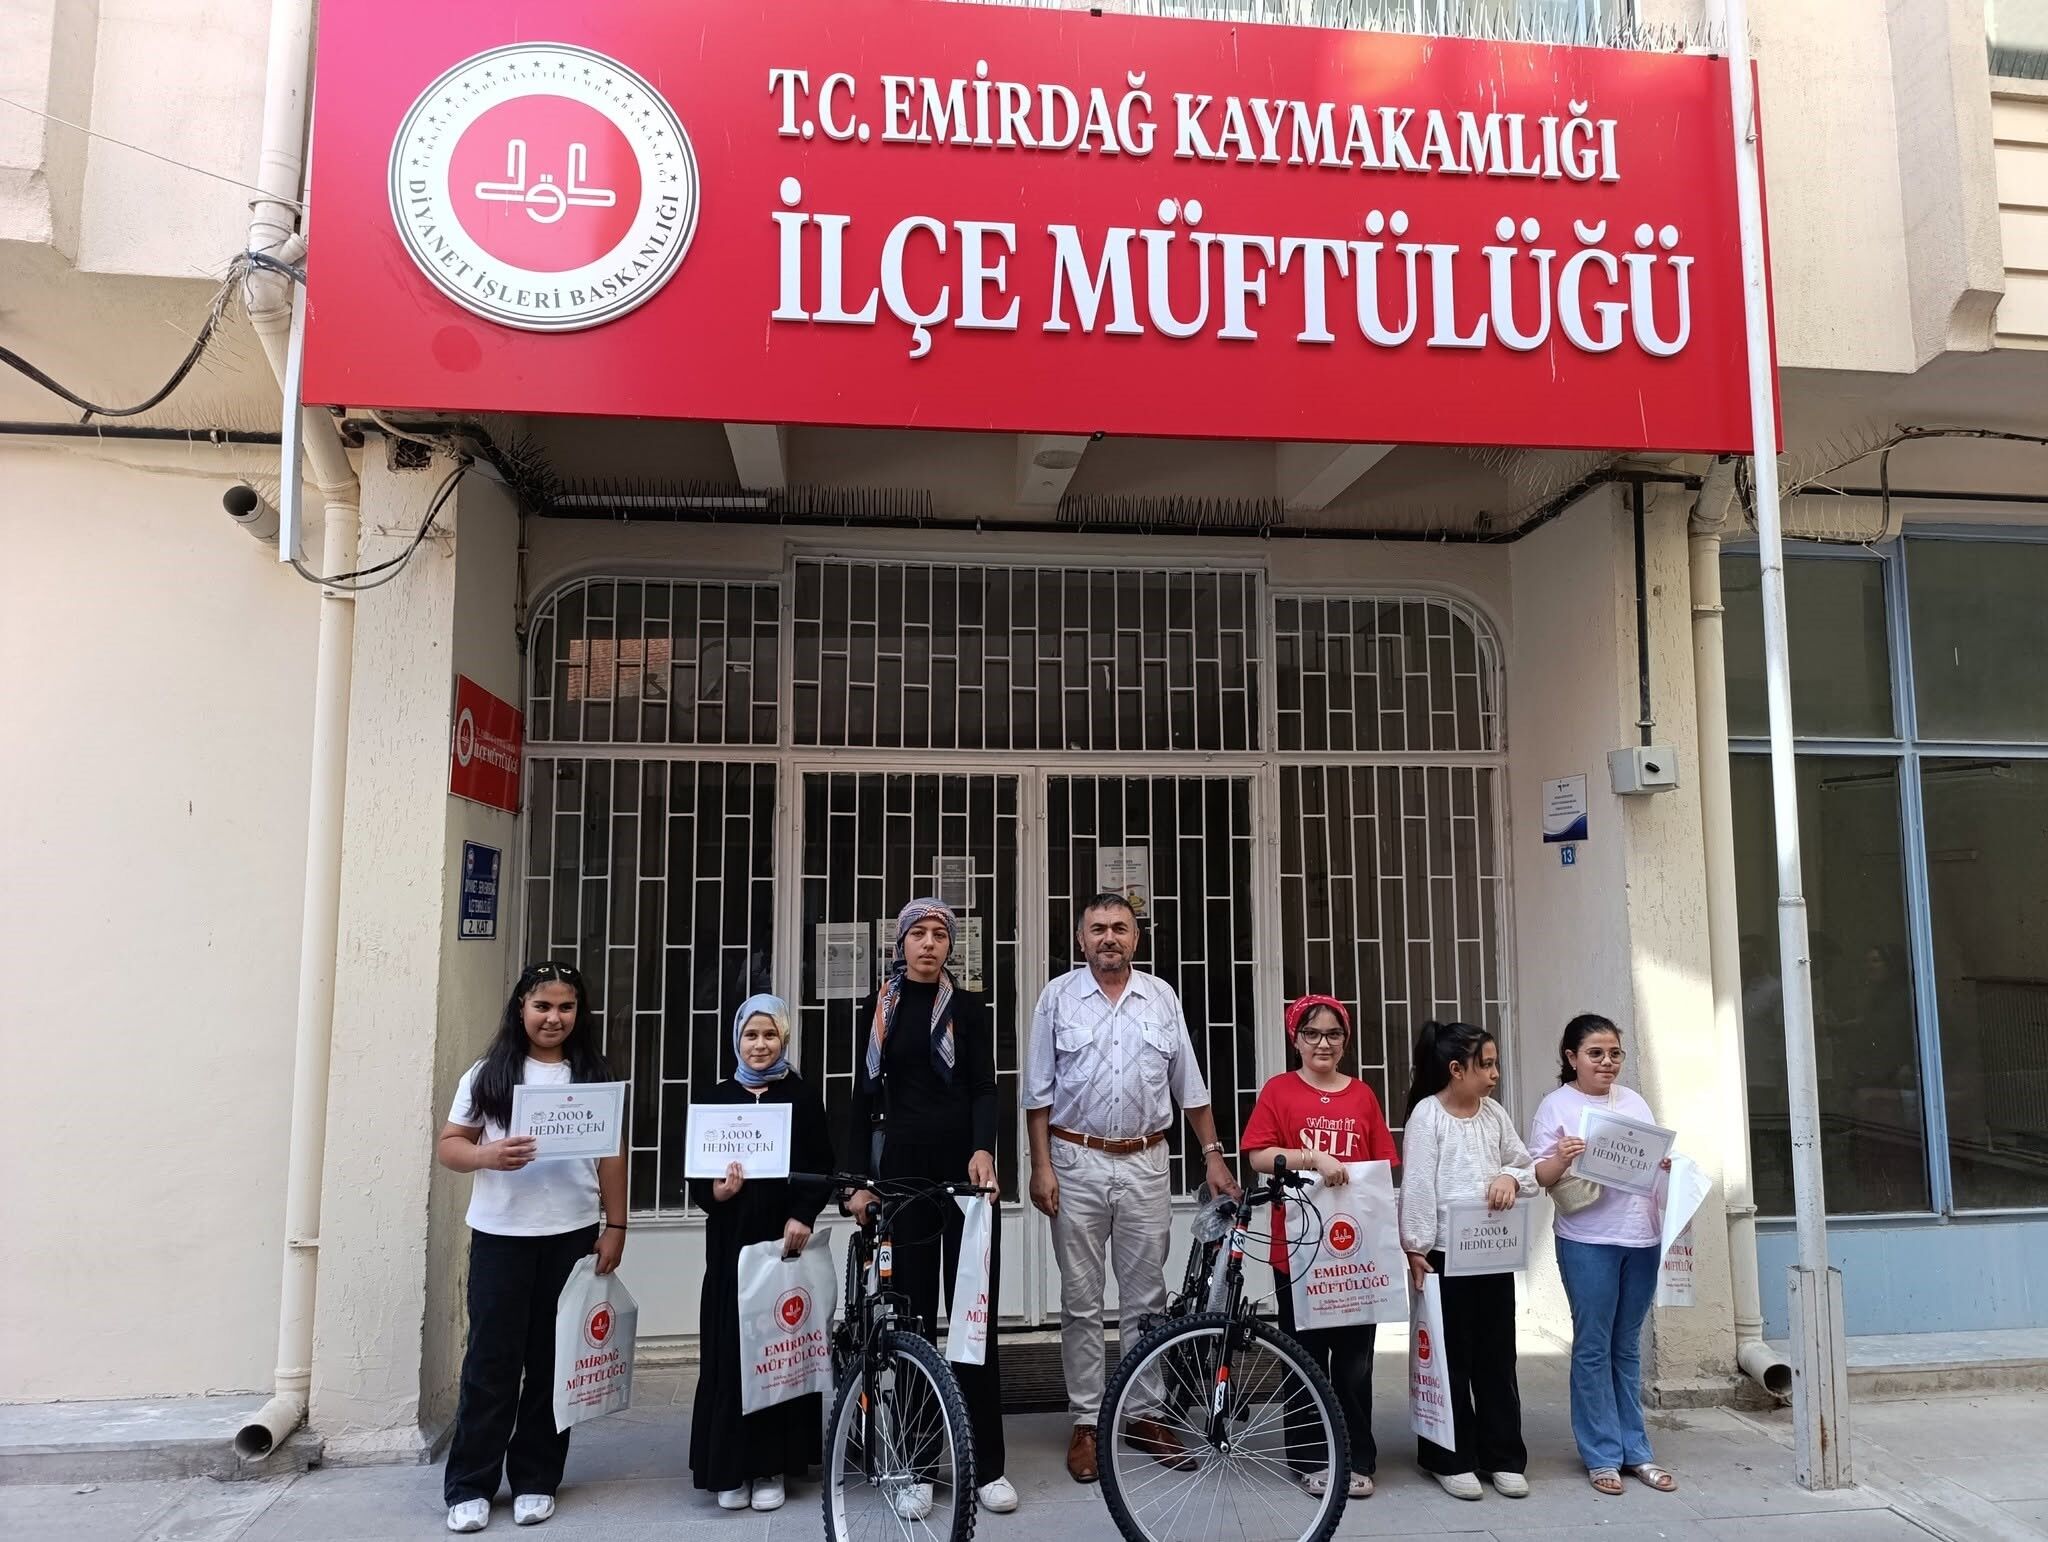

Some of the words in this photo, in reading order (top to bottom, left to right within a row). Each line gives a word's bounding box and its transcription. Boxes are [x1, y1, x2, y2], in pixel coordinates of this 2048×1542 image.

[768, 67, 870, 143] T.C.
[880, 59, 1158, 157] EMİRDAĞ
[1173, 92, 1622, 182] KAYMAKAMLIĞI
[409, 179, 474, 278] DİYANET
[473, 271, 561, 309] İŞLERİ
[569, 194, 679, 306] BAŞKANLIĞI
[771, 176, 1021, 359] İLÇE
[1042, 197, 1695, 358] MÜFTÜLÜĞÜ
[1563, 849, 1573, 863] 13
[476, 920, 489, 933] KAT
[547, 1110, 584, 1121] 2.000
[1306, 1115, 1344, 1131] what
[529, 1122, 575, 1136] HEDİYE
[577, 1119, 605, 1135] ÇEKİ
[719, 1129, 753, 1140] 3.000
[703, 1141, 745, 1153] HEDİYE
[747, 1140, 774, 1154] ÇEKİ
[1299, 1127, 1361, 1157] SELF
[1592, 1146, 1629, 1165] HEDİYE
[1473, 1226, 1501, 1237] 2.000
[1460, 1237, 1494, 1251] HEDİYE
[1496, 1235, 1517, 1250] ÇEKİ
[1313, 1260, 1376, 1279] EMİRDAĞ
[1306, 1275, 1390, 1296] MÜFTÜLÜĞÜ
[765, 1329, 823, 1356] EMİRDAĞ
[575, 1348, 619, 1371] EMİRDAĞ
[566, 1361, 627, 1391] MÜFTÜLÜĞÜ
